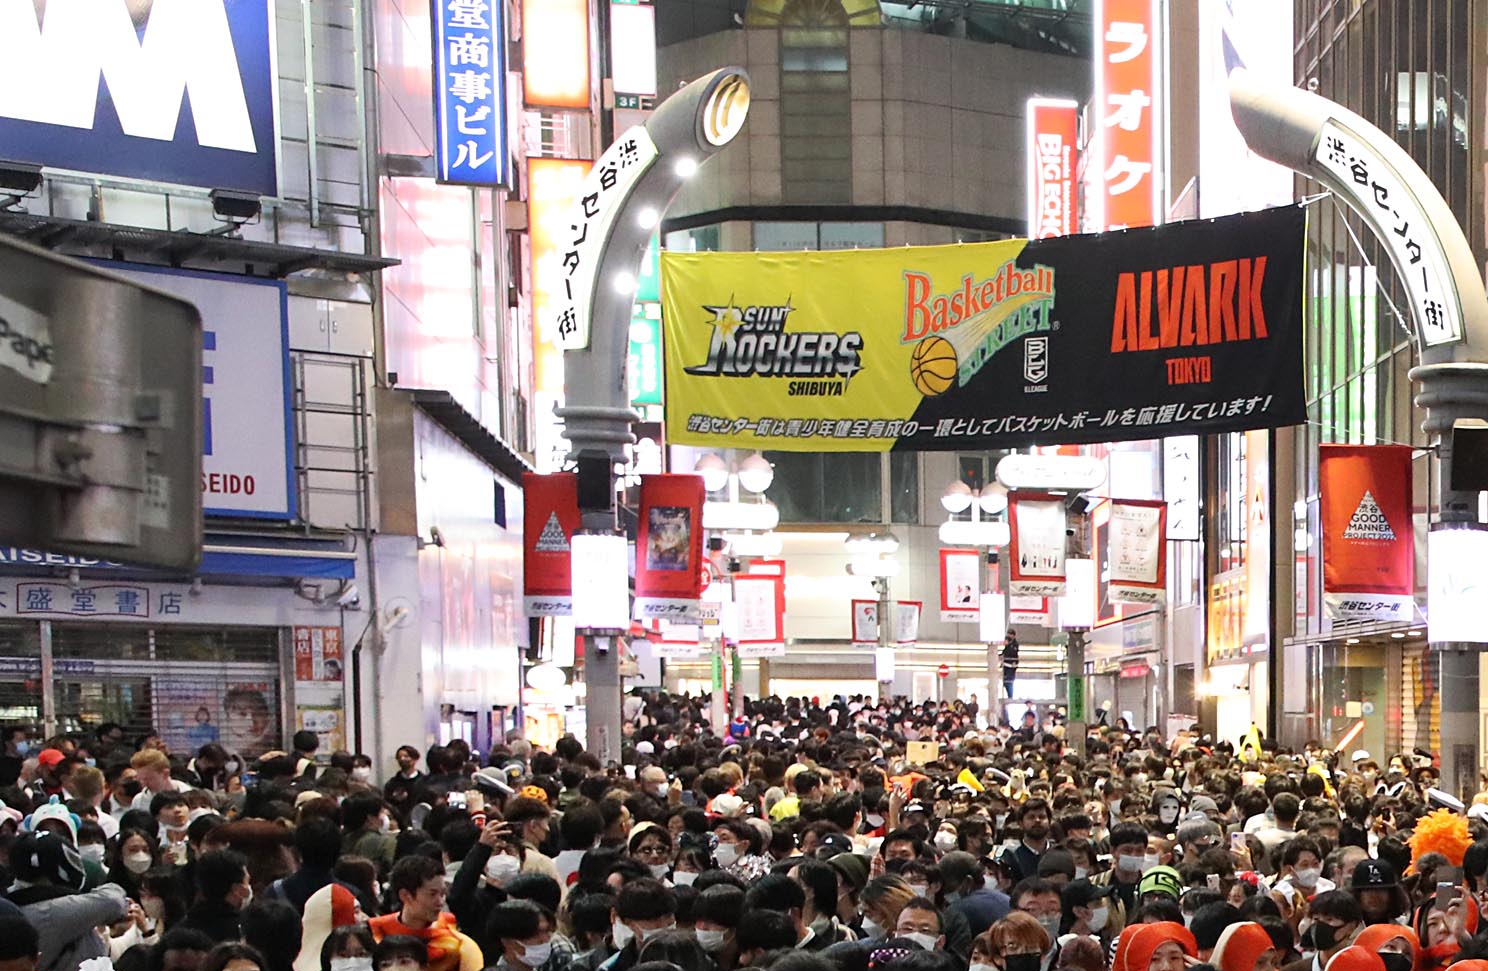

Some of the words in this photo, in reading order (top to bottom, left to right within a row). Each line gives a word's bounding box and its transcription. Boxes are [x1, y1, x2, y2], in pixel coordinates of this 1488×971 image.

[619, 97, 636, 107] 3F
[1038, 133, 1062, 180] BIG
[557, 139, 639, 341] 渋谷センター街
[1327, 136, 1444, 330] 渋谷センター街
[743, 306, 788, 332] SUN
[902, 262, 1053, 342] Basketball
[1111, 256, 1269, 353] ALVARK
[684, 302, 863, 378] ROCKERS
[959, 299, 1054, 388] STREET
[788, 381, 842, 396] SHIBUYA
[1165, 356, 1212, 385] TOKYO
[1348, 523, 1391, 532] MANNER
[1350, 513, 1387, 523] GOOD
[1339, 600, 1401, 612] 渋谷センター街
